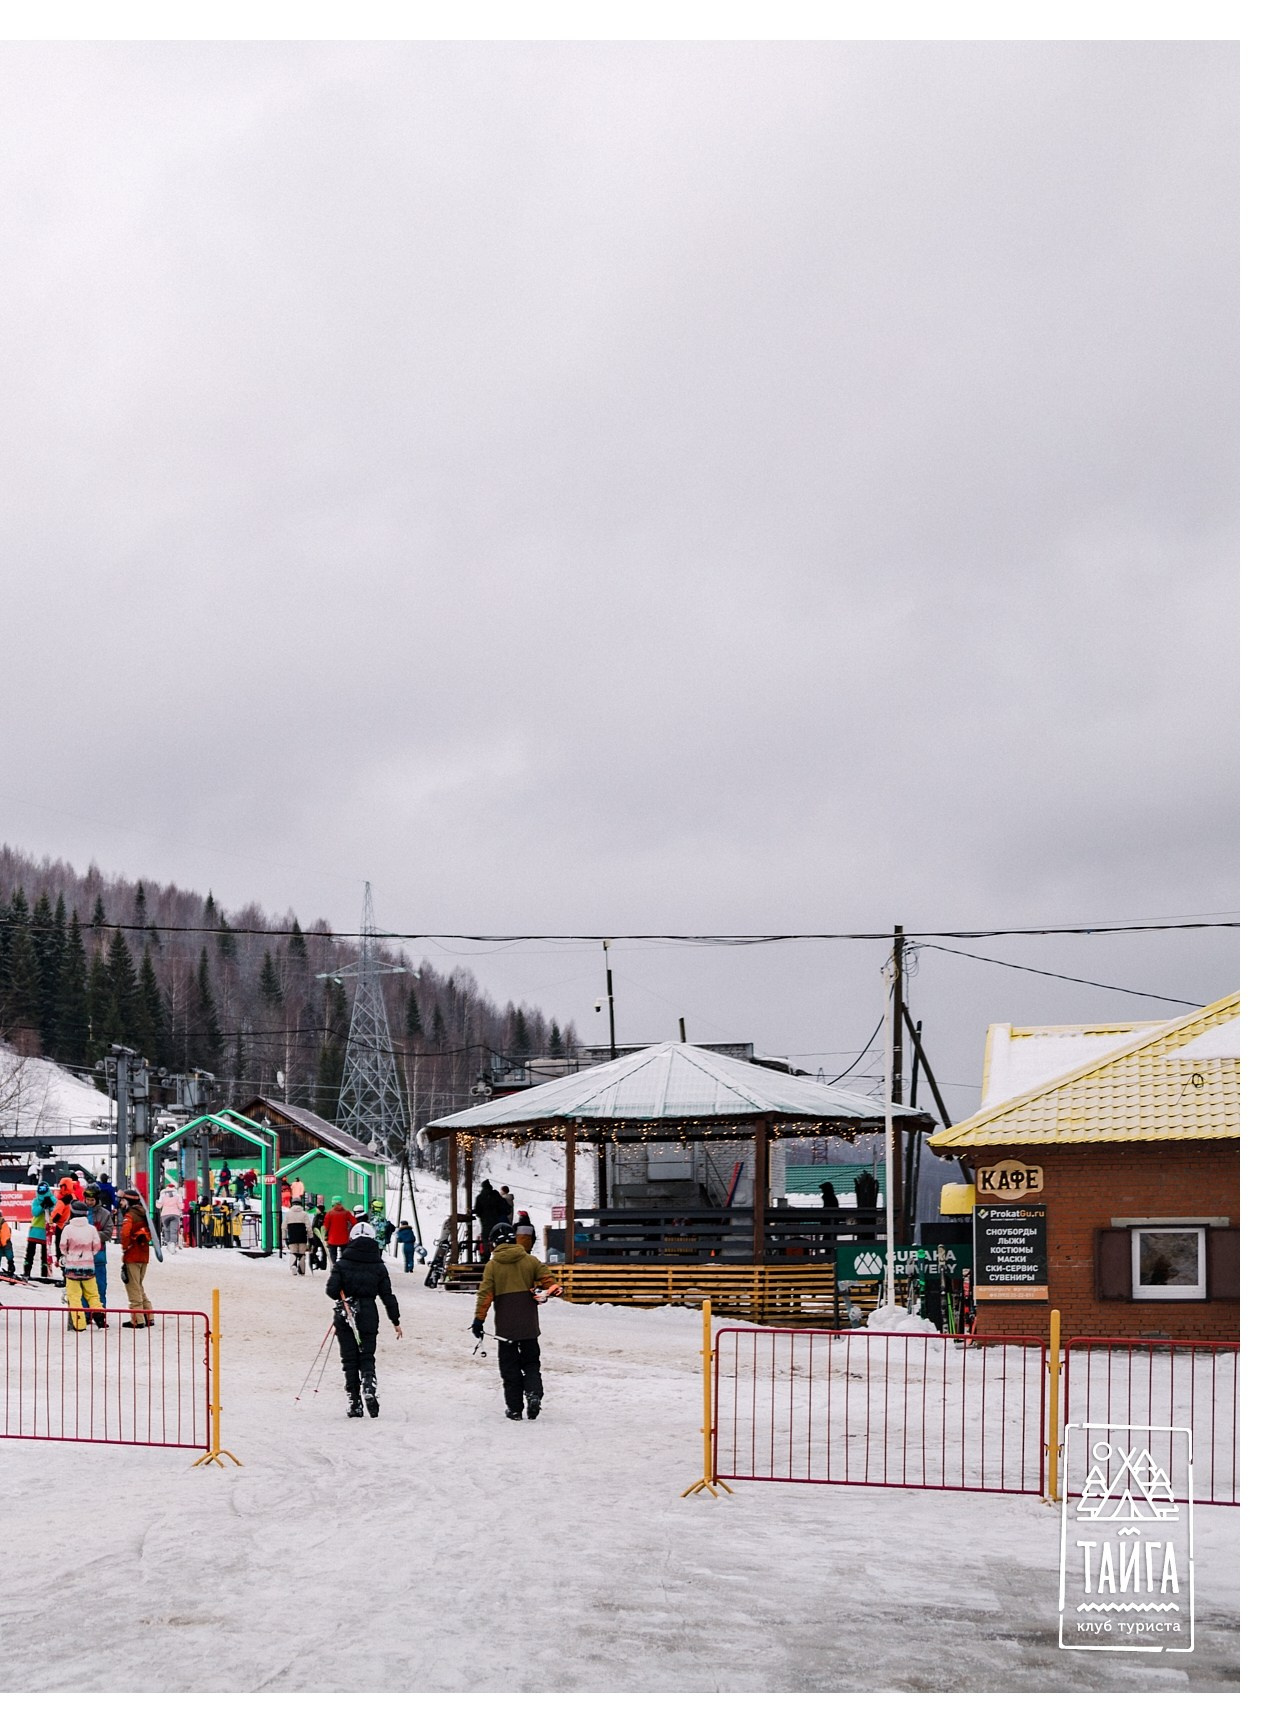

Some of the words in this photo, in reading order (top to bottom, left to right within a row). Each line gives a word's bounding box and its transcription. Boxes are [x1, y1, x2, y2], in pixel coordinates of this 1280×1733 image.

[981, 1170, 1038, 1190] КАФЕ
[990, 1210, 1045, 1218] ProkatGu.ru
[985, 1228, 1037, 1236] СНОУБОРДЫ
[997, 1237, 1026, 1245] ЛЫЖИ
[990, 1246, 1033, 1254] КОСТЮМЫ
[997, 1255, 1026, 1263] МАСКИ
[885, 1264, 957, 1274] RWERY
